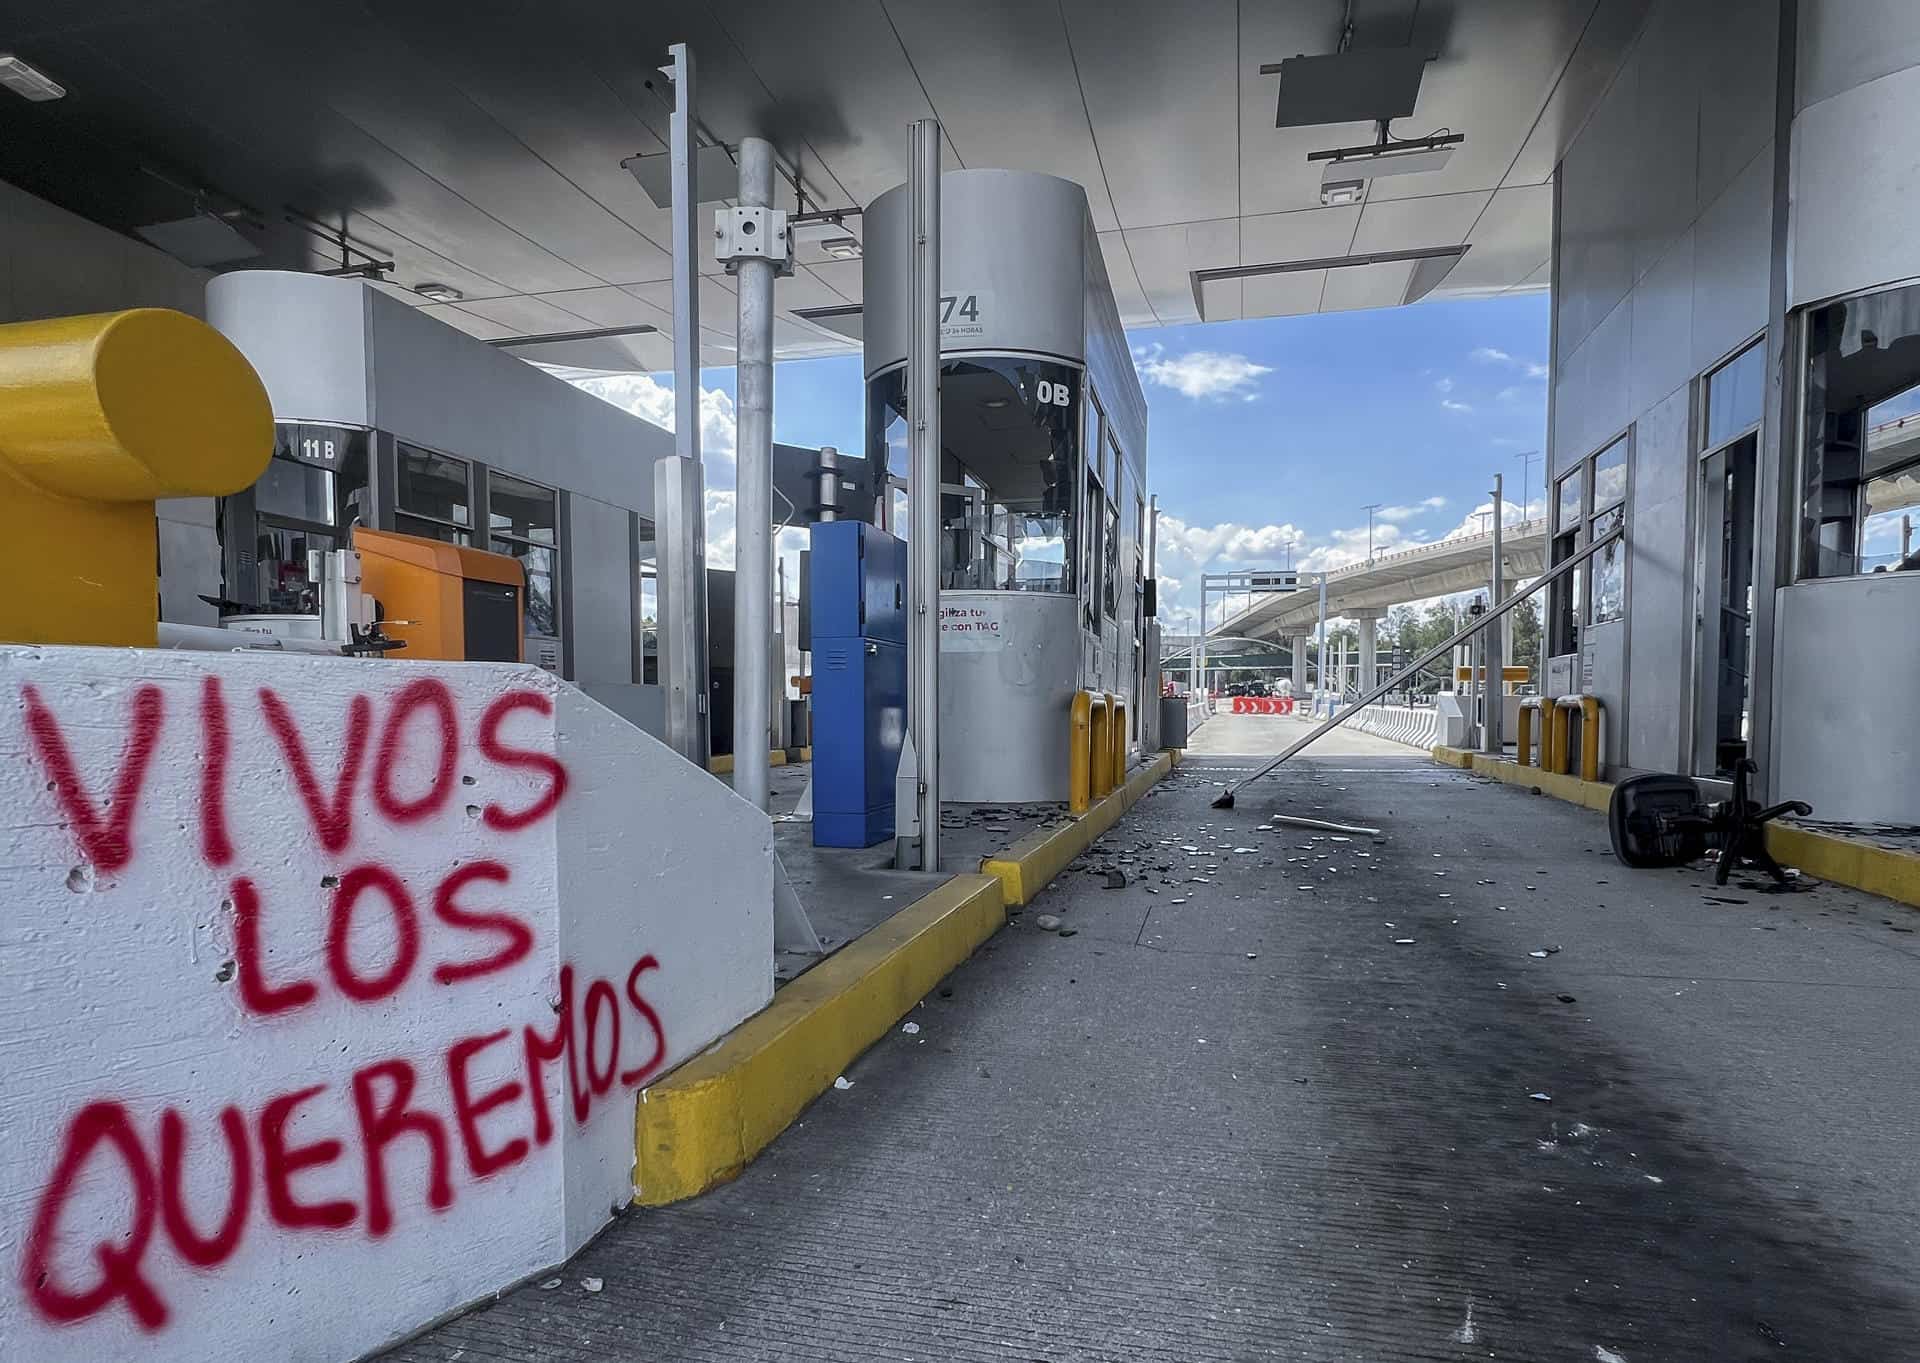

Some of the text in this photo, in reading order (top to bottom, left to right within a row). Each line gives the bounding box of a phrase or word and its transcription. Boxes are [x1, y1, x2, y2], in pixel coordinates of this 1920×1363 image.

[303, 439, 335, 459] 11 B
[975, 622, 998, 631] TAG
[22, 676, 570, 873] VIVOS
[229, 860, 534, 1016] LOS
[24, 954, 668, 1332] QUEREMOS
